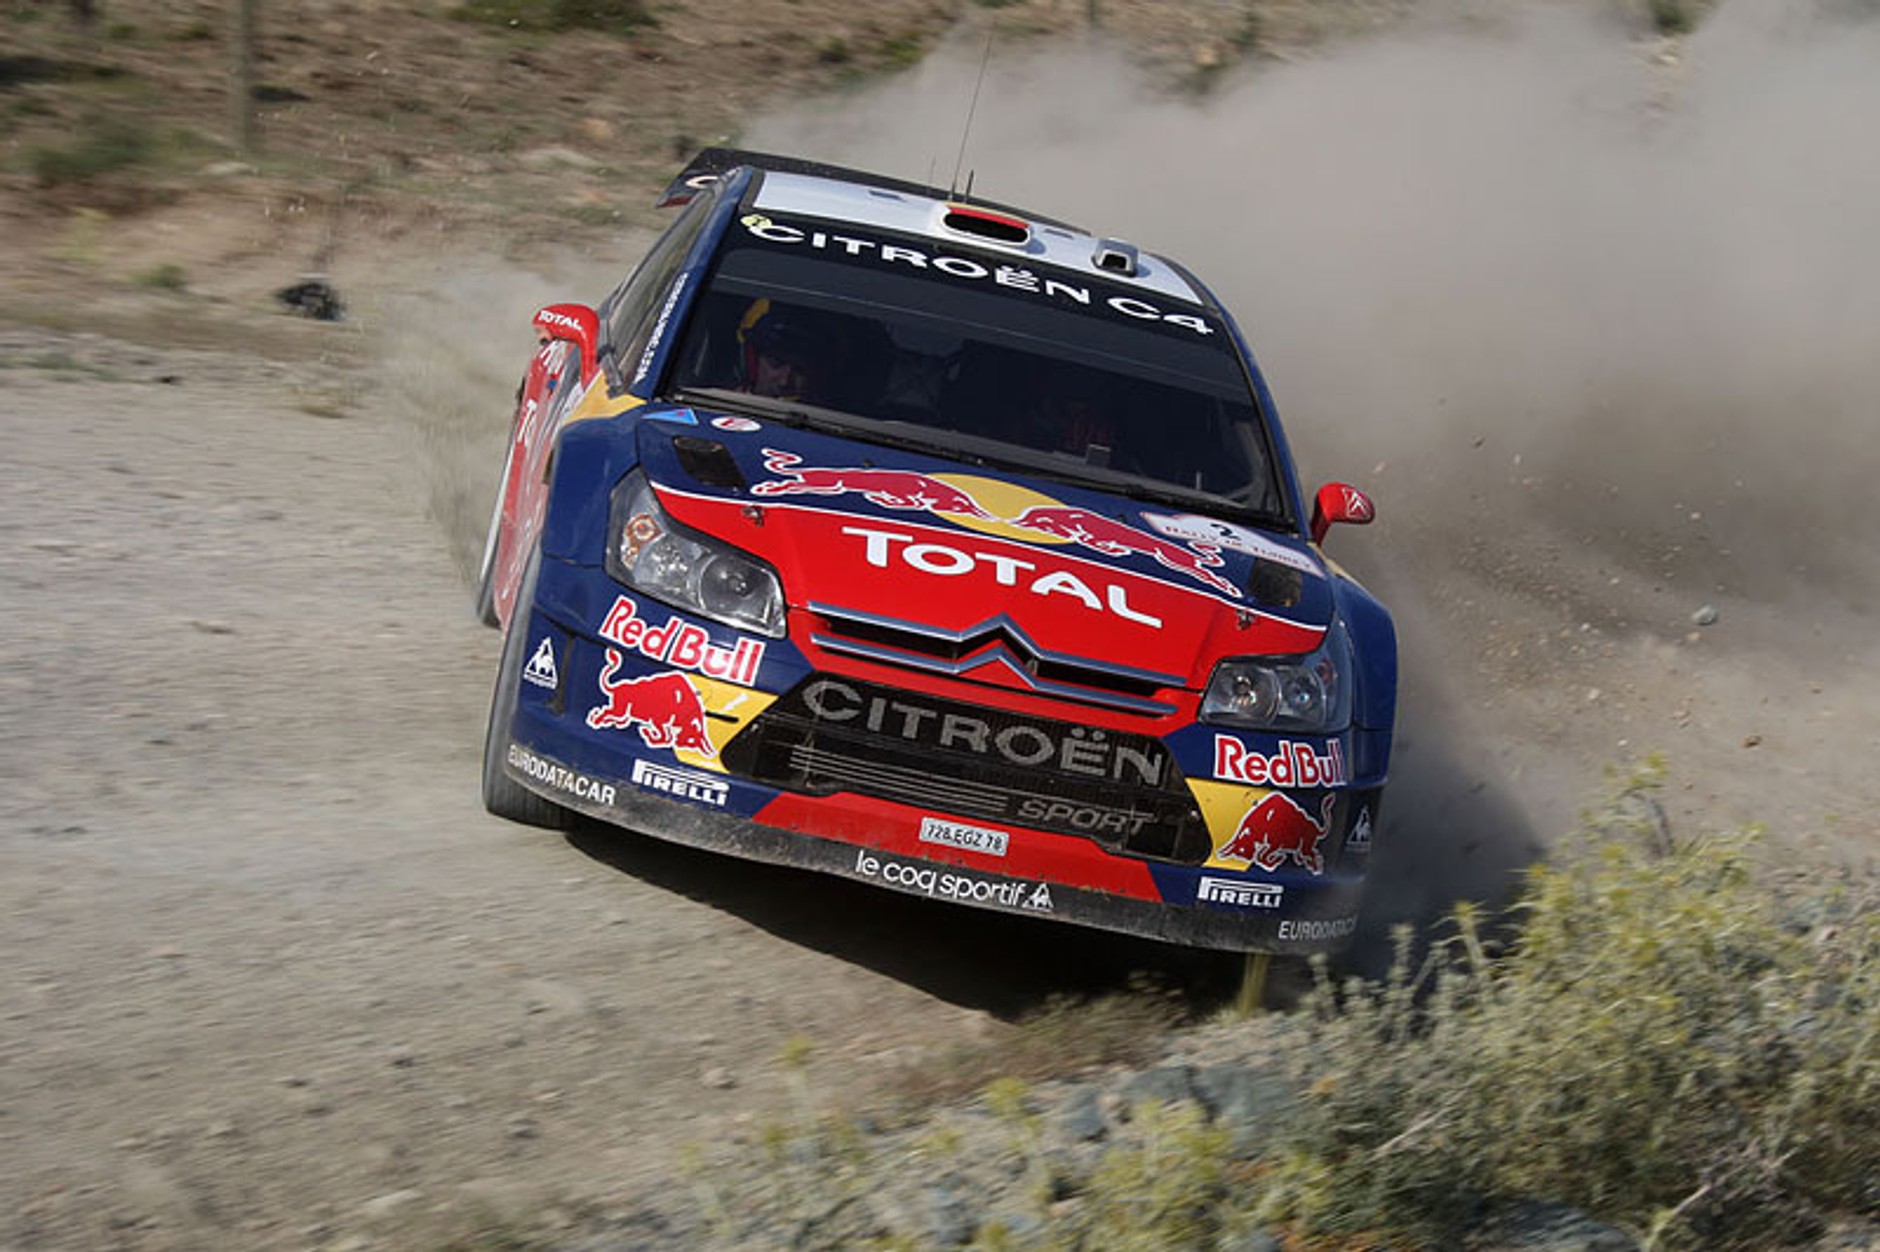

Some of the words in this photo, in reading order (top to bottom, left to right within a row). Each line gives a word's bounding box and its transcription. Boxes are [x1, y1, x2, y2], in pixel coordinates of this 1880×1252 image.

[748, 222, 1091, 304] CITROËN
[1108, 296, 1214, 336] C4
[536, 309, 584, 331] TOTAL
[1209, 523, 1243, 541] 2
[841, 525, 1163, 629] TOTAL
[802, 680, 1163, 786] CITROËN
[507, 744, 617, 806] EURODATACAR
[632, 758, 730, 807] PIRELLI
[1017, 797, 1158, 836] SPORT
[855, 851, 880, 875] le
[883, 862, 937, 896] coq
[939, 873, 1027, 906] sportif
[1197, 876, 1284, 909] PIRELLI
